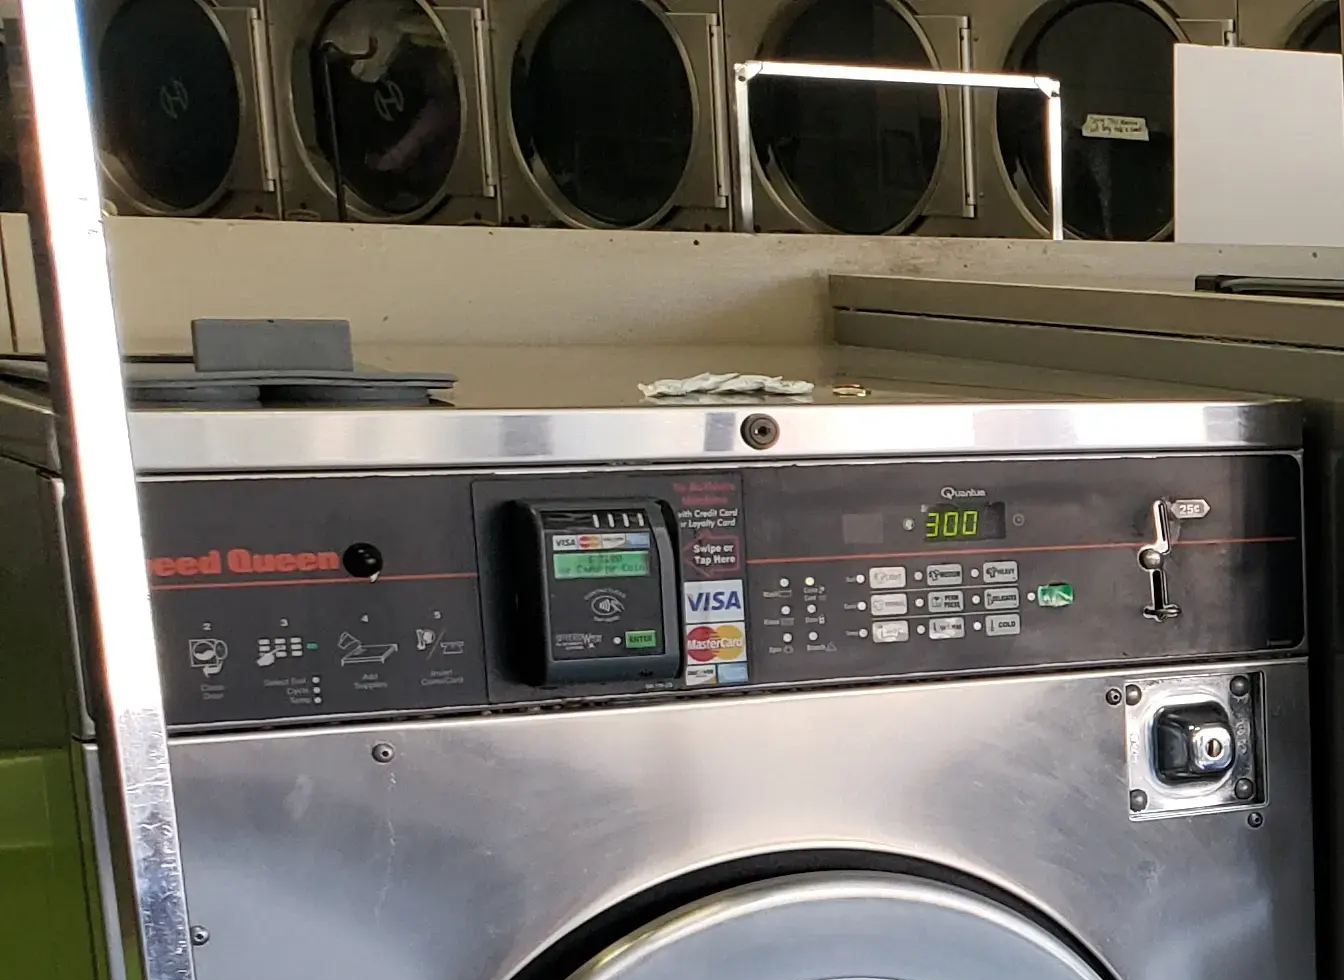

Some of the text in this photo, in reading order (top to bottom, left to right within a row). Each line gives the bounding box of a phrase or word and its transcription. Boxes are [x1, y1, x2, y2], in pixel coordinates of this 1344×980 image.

[694, 509, 717, 518] Credit
[719, 508, 738, 517] Card
[1179, 504, 1201, 515] 25¢
[688, 520, 715, 529] Loyalty
[717, 518, 736, 527] Card
[926, 510, 978, 538] 300
[556, 538, 576, 547] VISA
[693, 545, 734, 554] Swipe or
[227, 548, 341, 573] Queen
[694, 555, 736, 566] Tap Here
[687, 591, 742, 612] VISA
[203, 622, 212, 631] 2
[280, 618, 289, 627] 3
[360, 614, 369, 623] 4
[629, 635, 653, 644] ENTER
[687, 636, 744, 650] MasterCard
